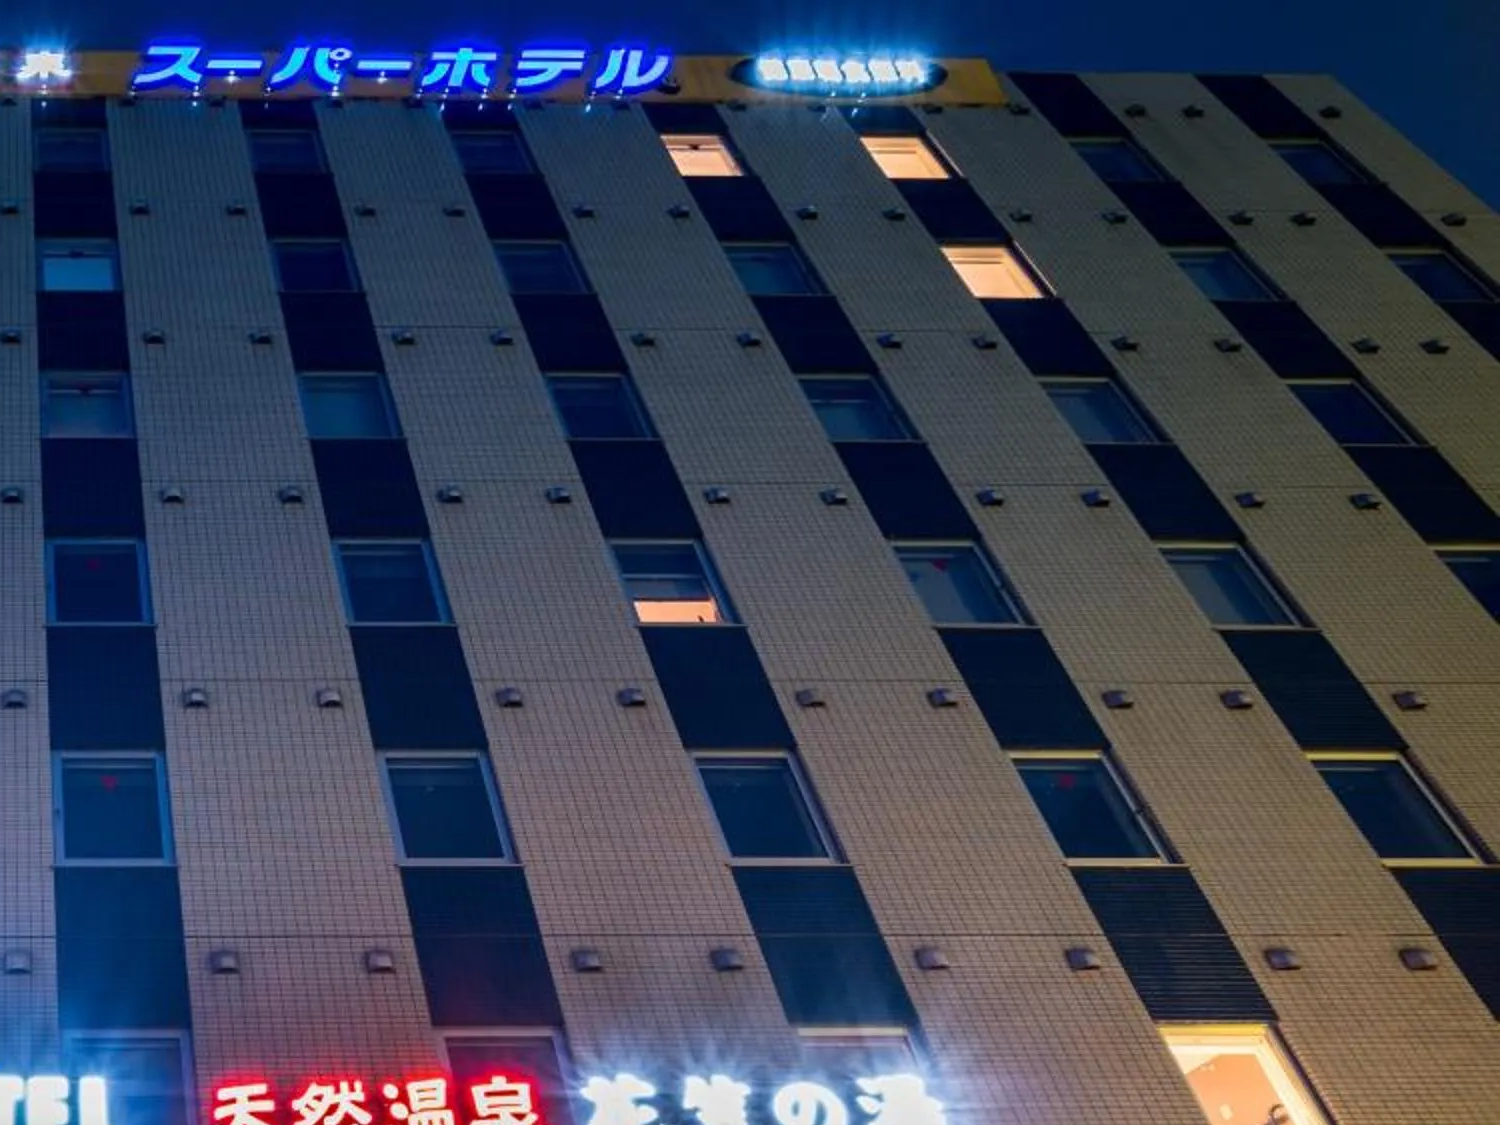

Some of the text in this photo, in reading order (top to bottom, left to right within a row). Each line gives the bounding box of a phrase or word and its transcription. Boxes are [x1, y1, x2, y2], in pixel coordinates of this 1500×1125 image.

[132, 44, 669, 88] スーパーホテル
